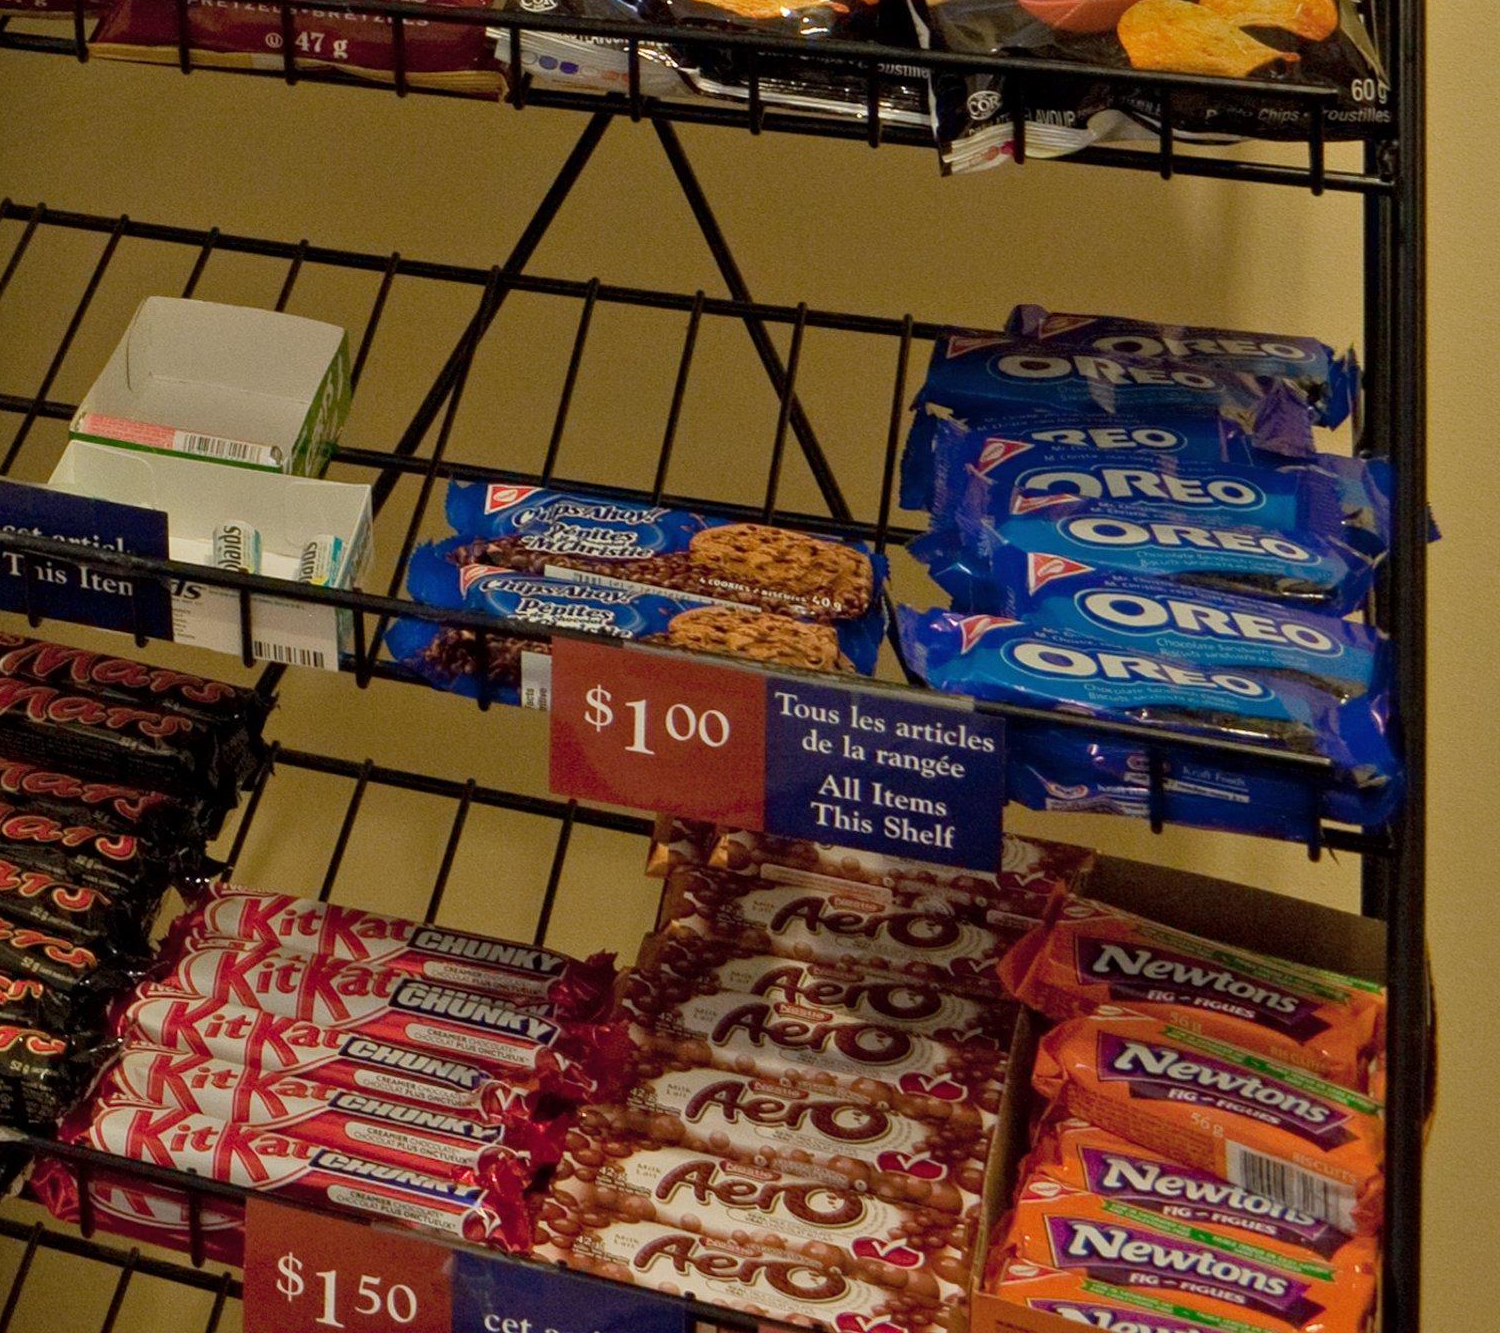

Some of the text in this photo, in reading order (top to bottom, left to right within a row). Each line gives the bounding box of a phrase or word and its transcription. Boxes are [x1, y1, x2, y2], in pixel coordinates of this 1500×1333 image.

[295, 32, 349, 59] 47 g
[1352, 78, 1375, 102] 60
[999, 354, 1217, 390] OREO
[1069, 518, 1309, 562] OREO
[1084, 593, 1334, 651] OREO
[775, 690, 843, 726] Tous
[850, 700, 885, 732] les
[896, 711, 995, 753] articles
[802, 724, 965, 779] de la rangée
[818, 773, 947, 816] All Items
[810, 801, 955, 849] This Shelf
[410, 930, 558, 974] CHUNKY
[1093, 945, 1299, 1014] Newtons
[1147, 989, 1255, 1019] FIG FIGUES
[1110, 1044, 1330, 1123] Newtons
[1168, 1088, 1281, 1125] FIG FIGUES
[1068, 1224, 1290, 1296] Newtons
